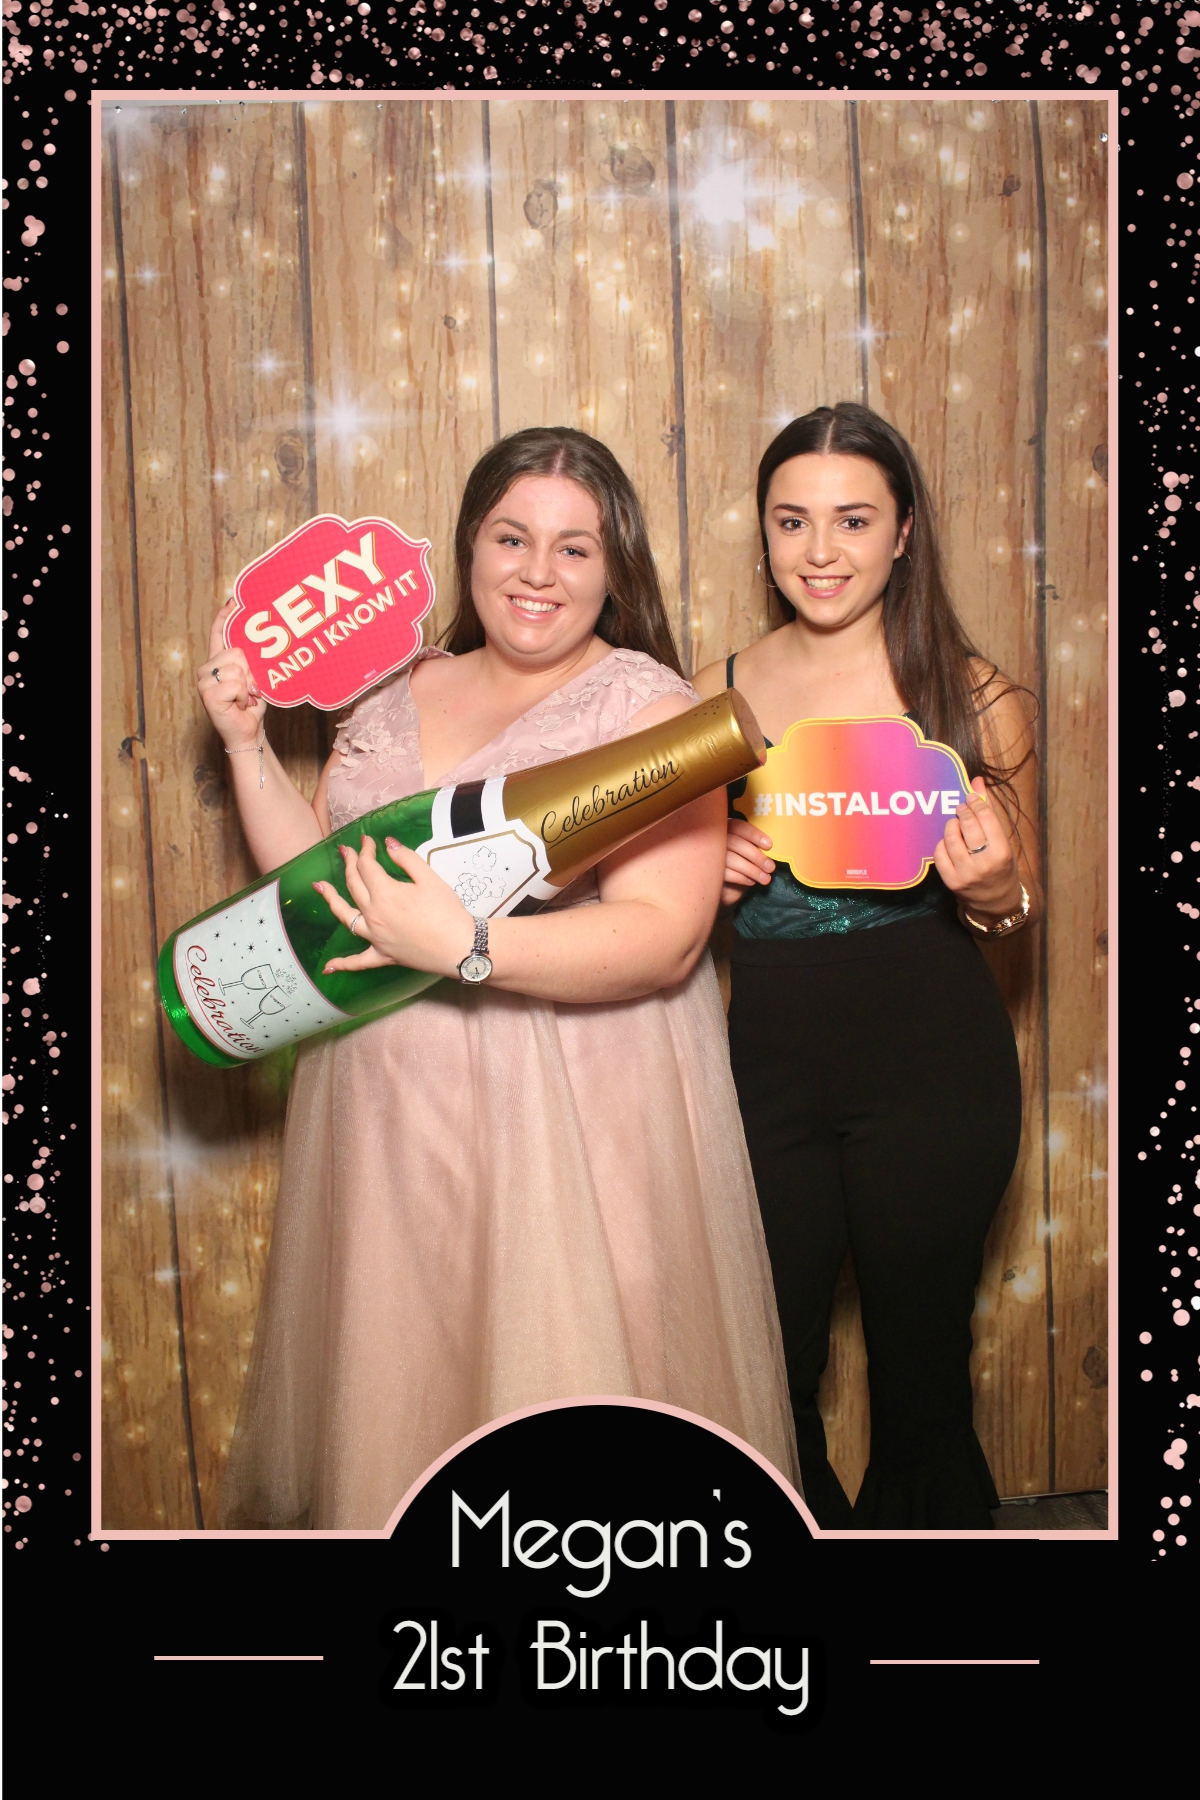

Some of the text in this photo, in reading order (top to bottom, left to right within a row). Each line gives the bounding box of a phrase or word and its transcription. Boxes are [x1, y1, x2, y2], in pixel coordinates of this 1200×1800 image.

[244, 531, 386, 659] SEXY
[266, 569, 419, 690] AND I KNOW IT
[541, 759, 680, 844] Celebration
[753, 790, 961, 817] #INSTALOVE
[187, 945, 265, 1054] Celebration
